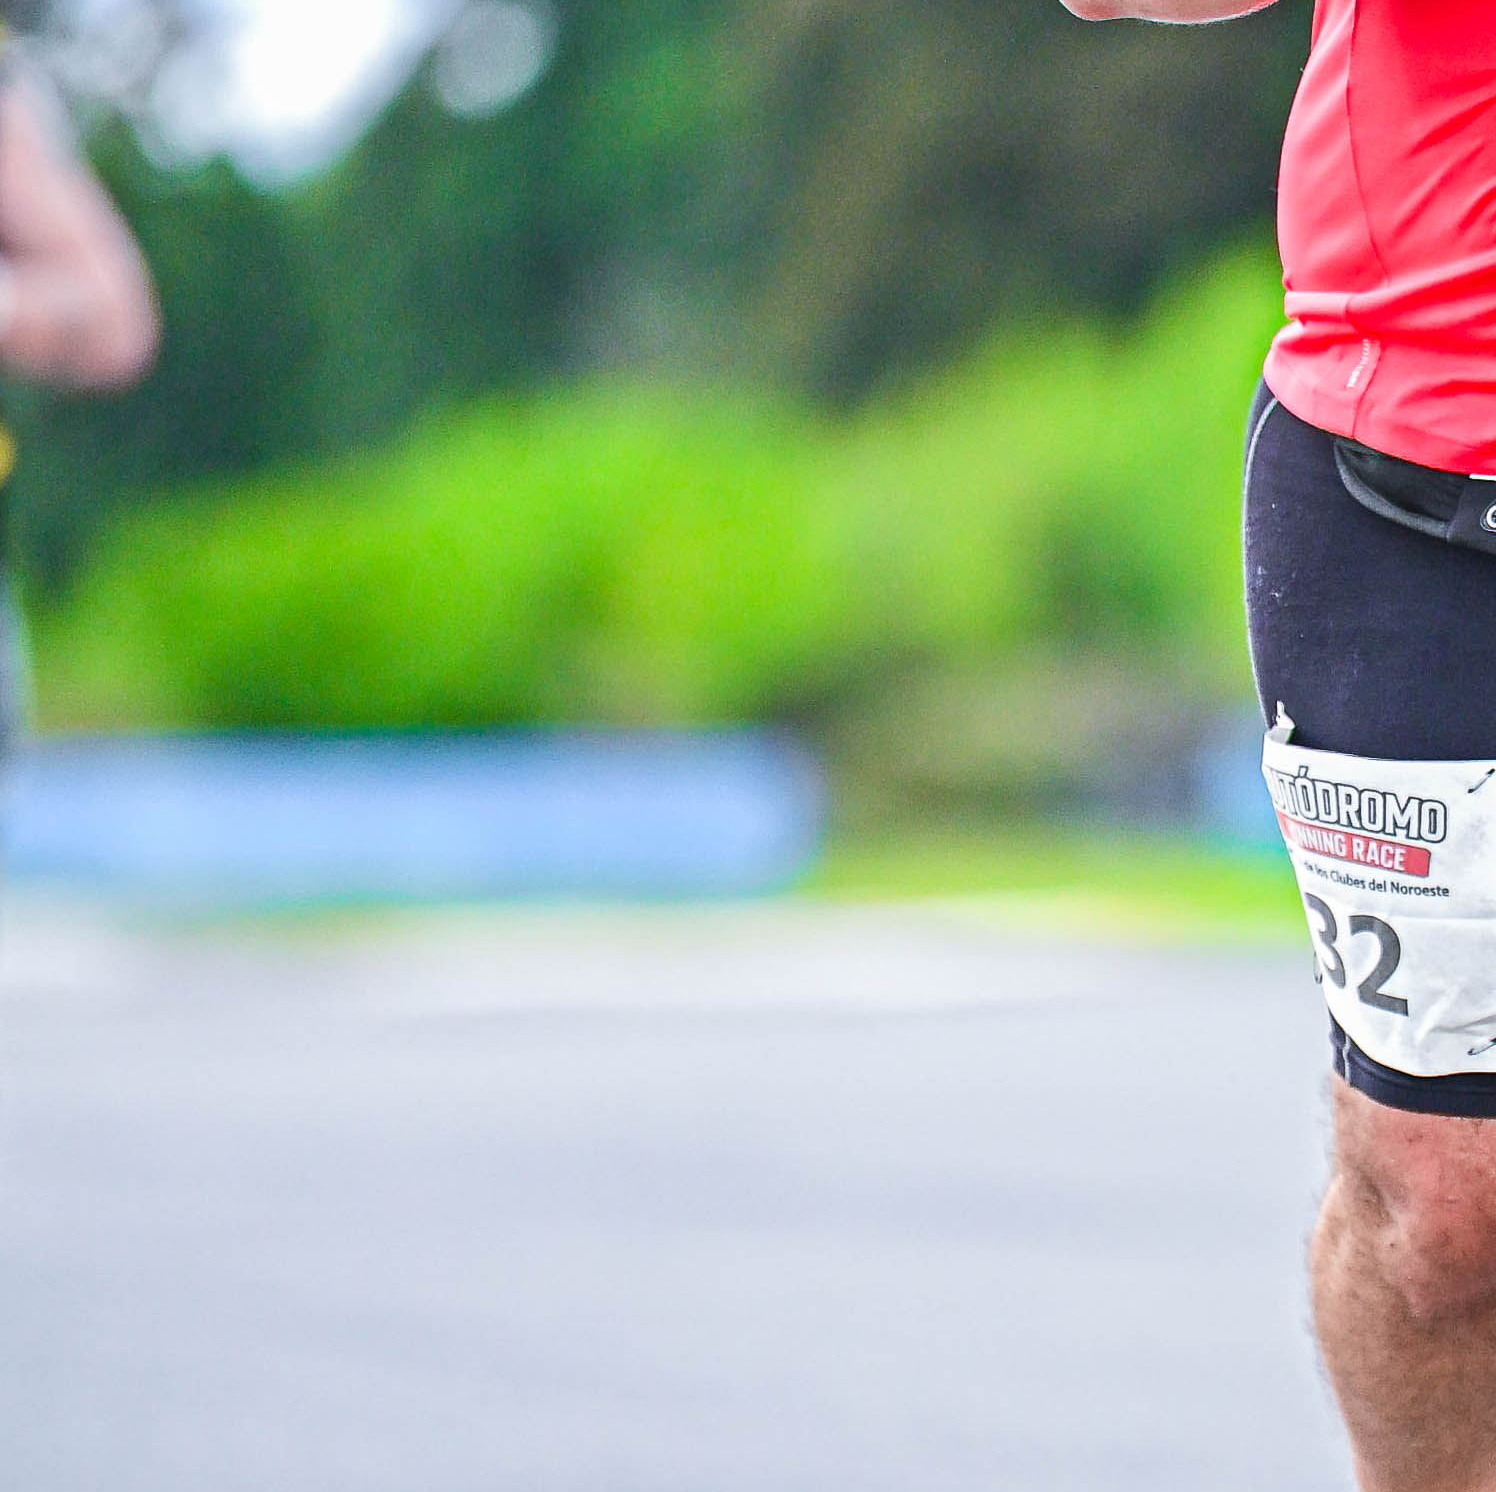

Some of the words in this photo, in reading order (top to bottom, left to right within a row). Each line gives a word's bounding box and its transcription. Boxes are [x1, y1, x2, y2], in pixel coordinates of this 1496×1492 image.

[1264, 764, 1447, 843] UTÓDROMO
[1352, 836, 1406, 872] RACE
[1330, 870, 1366, 890] Clubes
[1368, 878, 1387, 893] del
[1390, 882, 1450, 897] Noroeste
